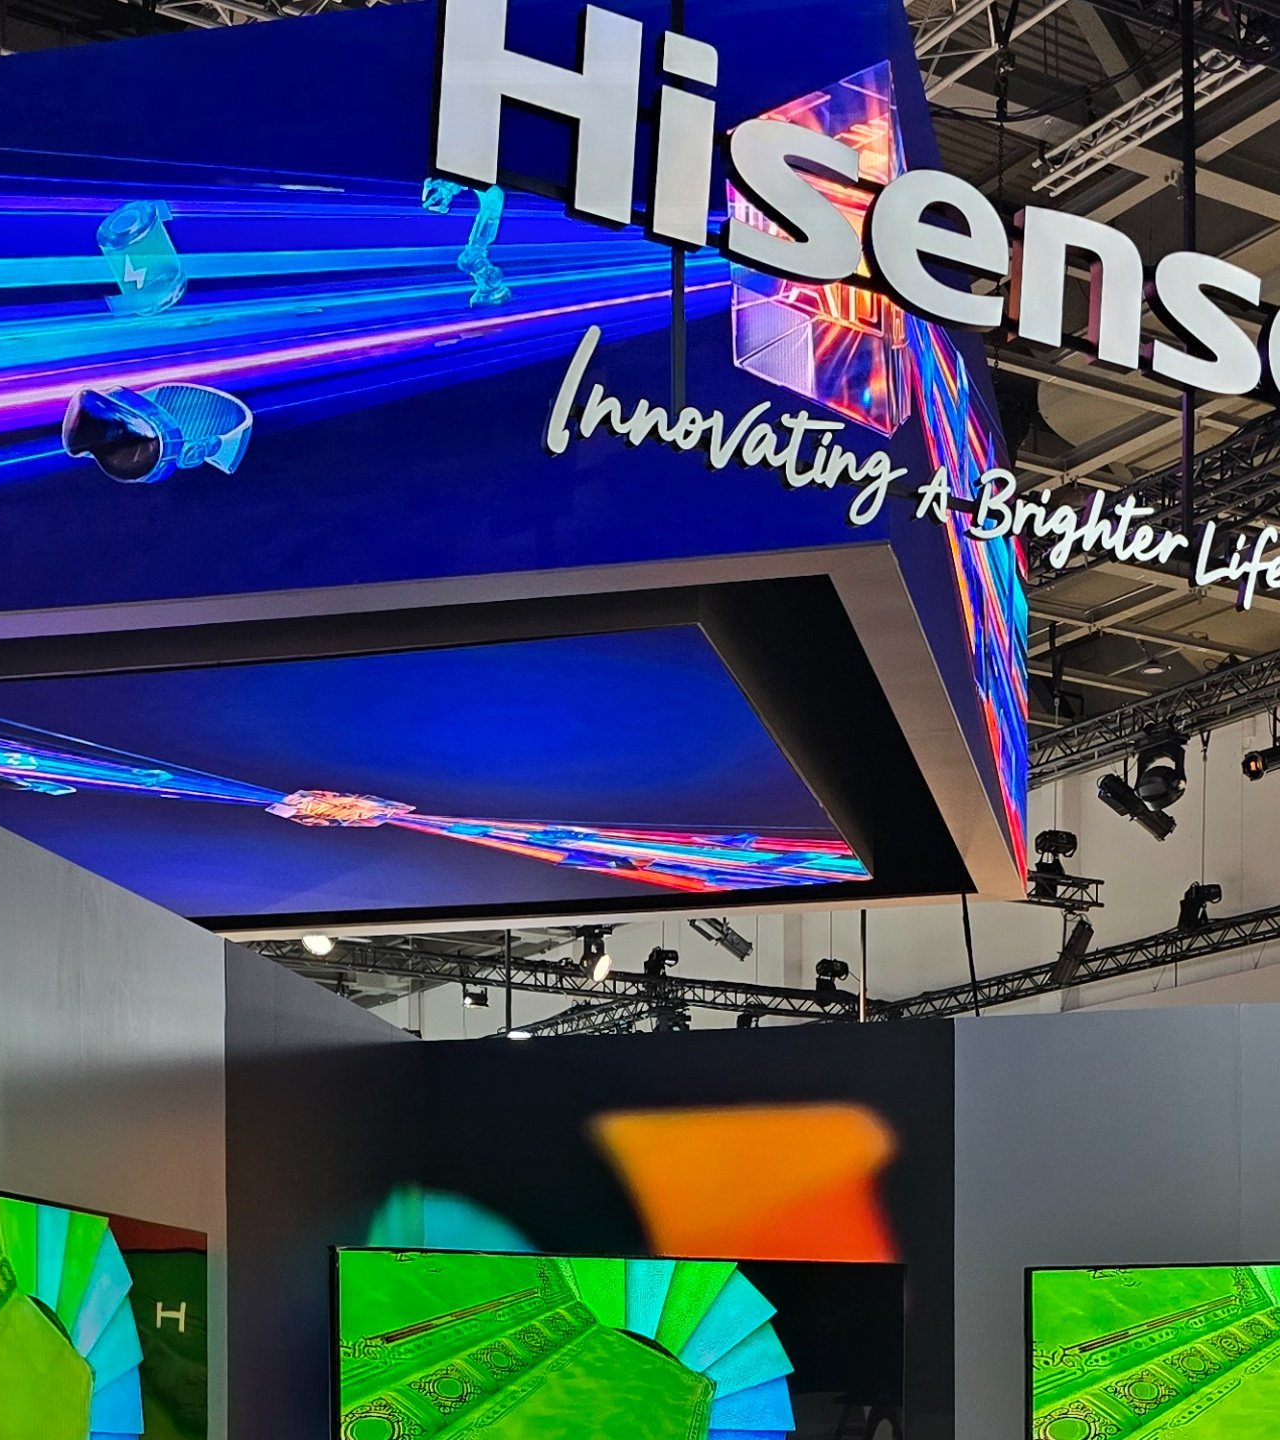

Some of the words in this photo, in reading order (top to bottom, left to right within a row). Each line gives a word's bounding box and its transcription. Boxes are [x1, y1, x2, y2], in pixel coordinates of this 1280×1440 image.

[546, 325, 908, 526] Innovating
[915, 478, 955, 523] A
[969, 468, 1189, 569] Brighter
